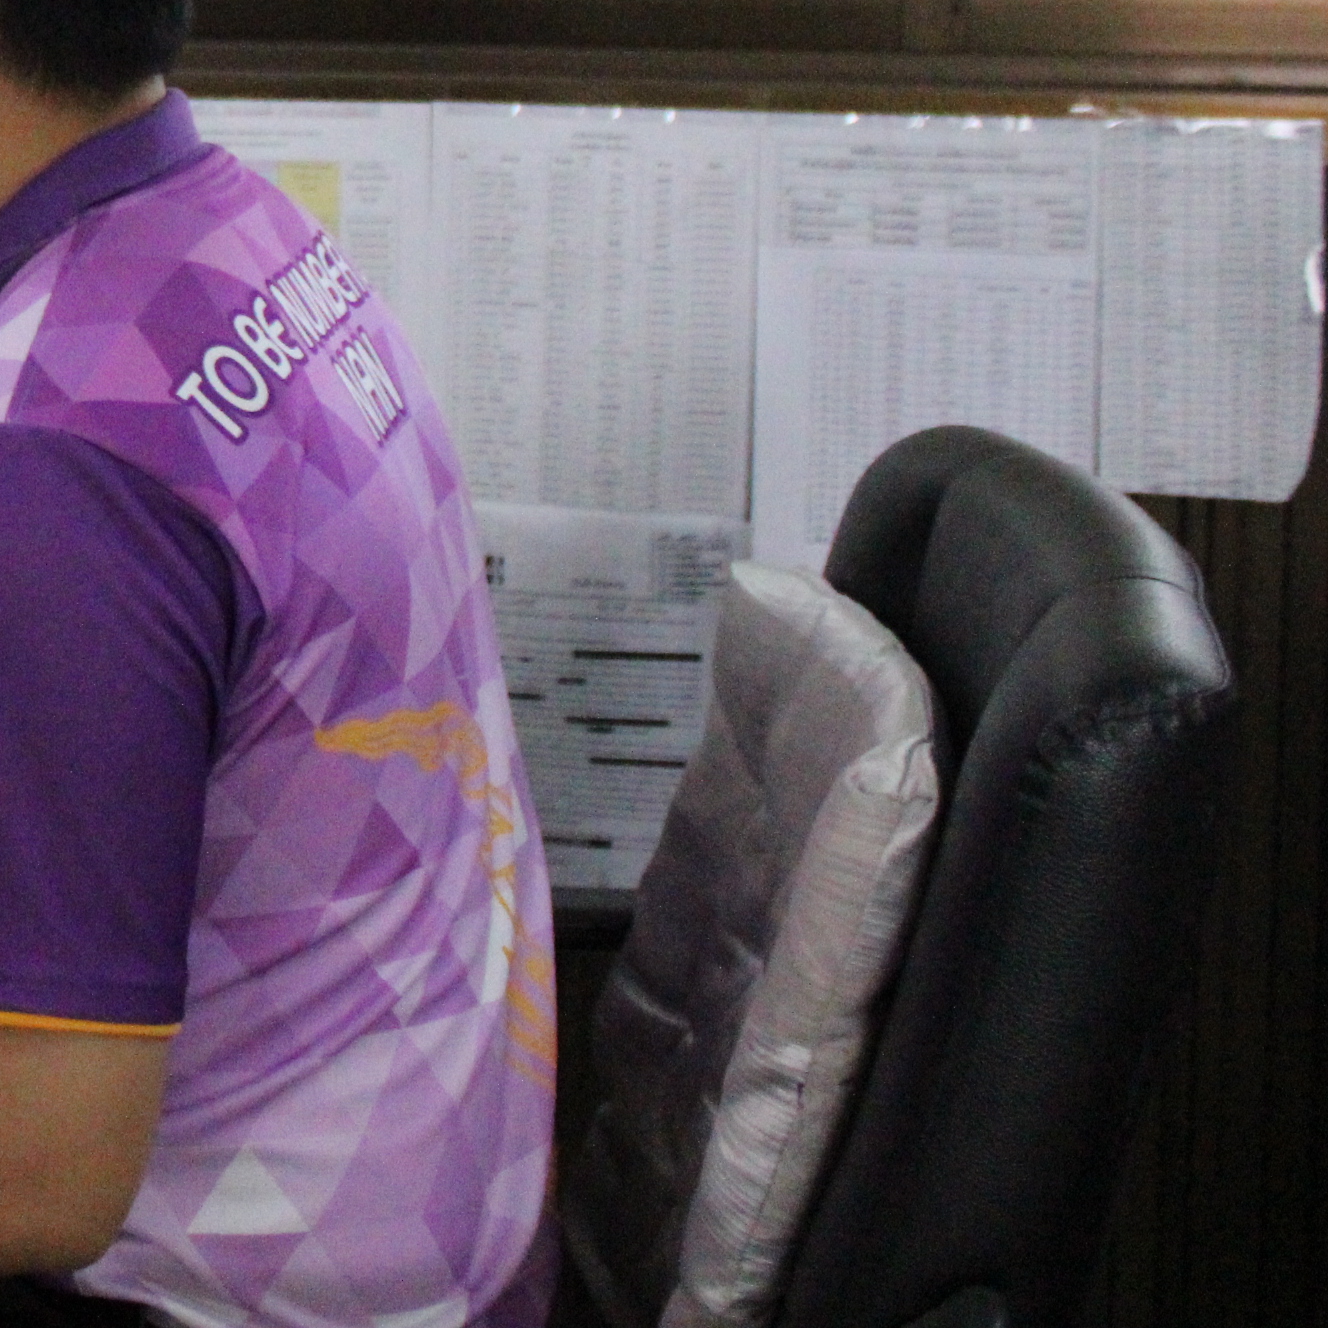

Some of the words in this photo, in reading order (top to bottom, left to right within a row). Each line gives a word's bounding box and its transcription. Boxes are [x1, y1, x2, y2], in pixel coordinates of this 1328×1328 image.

[177, 346, 269, 439] TO
[234, 297, 304, 379] BE
[333, 332, 404, 443] NAN
